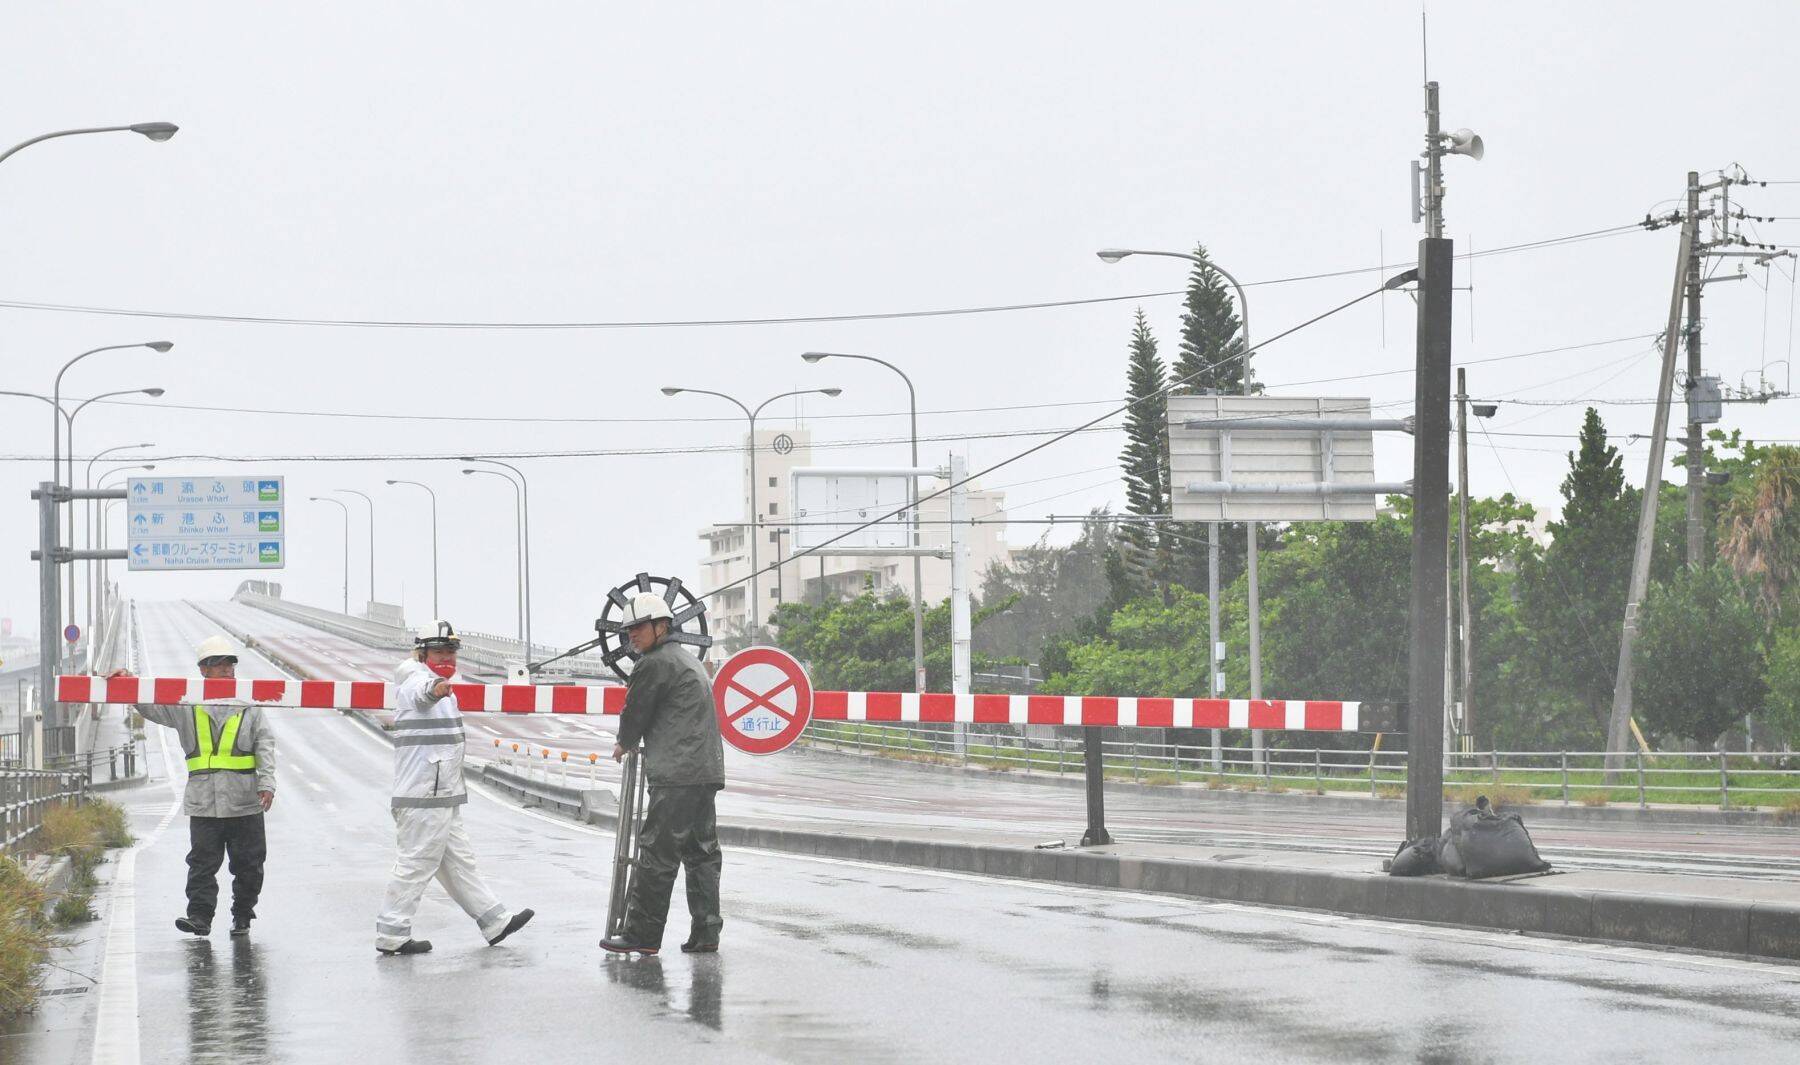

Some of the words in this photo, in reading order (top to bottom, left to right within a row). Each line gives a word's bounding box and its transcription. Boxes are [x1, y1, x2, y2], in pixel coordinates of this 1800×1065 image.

[177, 495, 204, 503] Urasoe
[151, 512, 256, 525] 新港ふ頭
[178, 526, 204, 534] Shinko
[152, 542, 256, 556] 那覇クルーズターミナル
[164, 557, 184, 565] Naha
[212, 556, 244, 564] Terminal
[742, 717, 782, 731] 通行止
